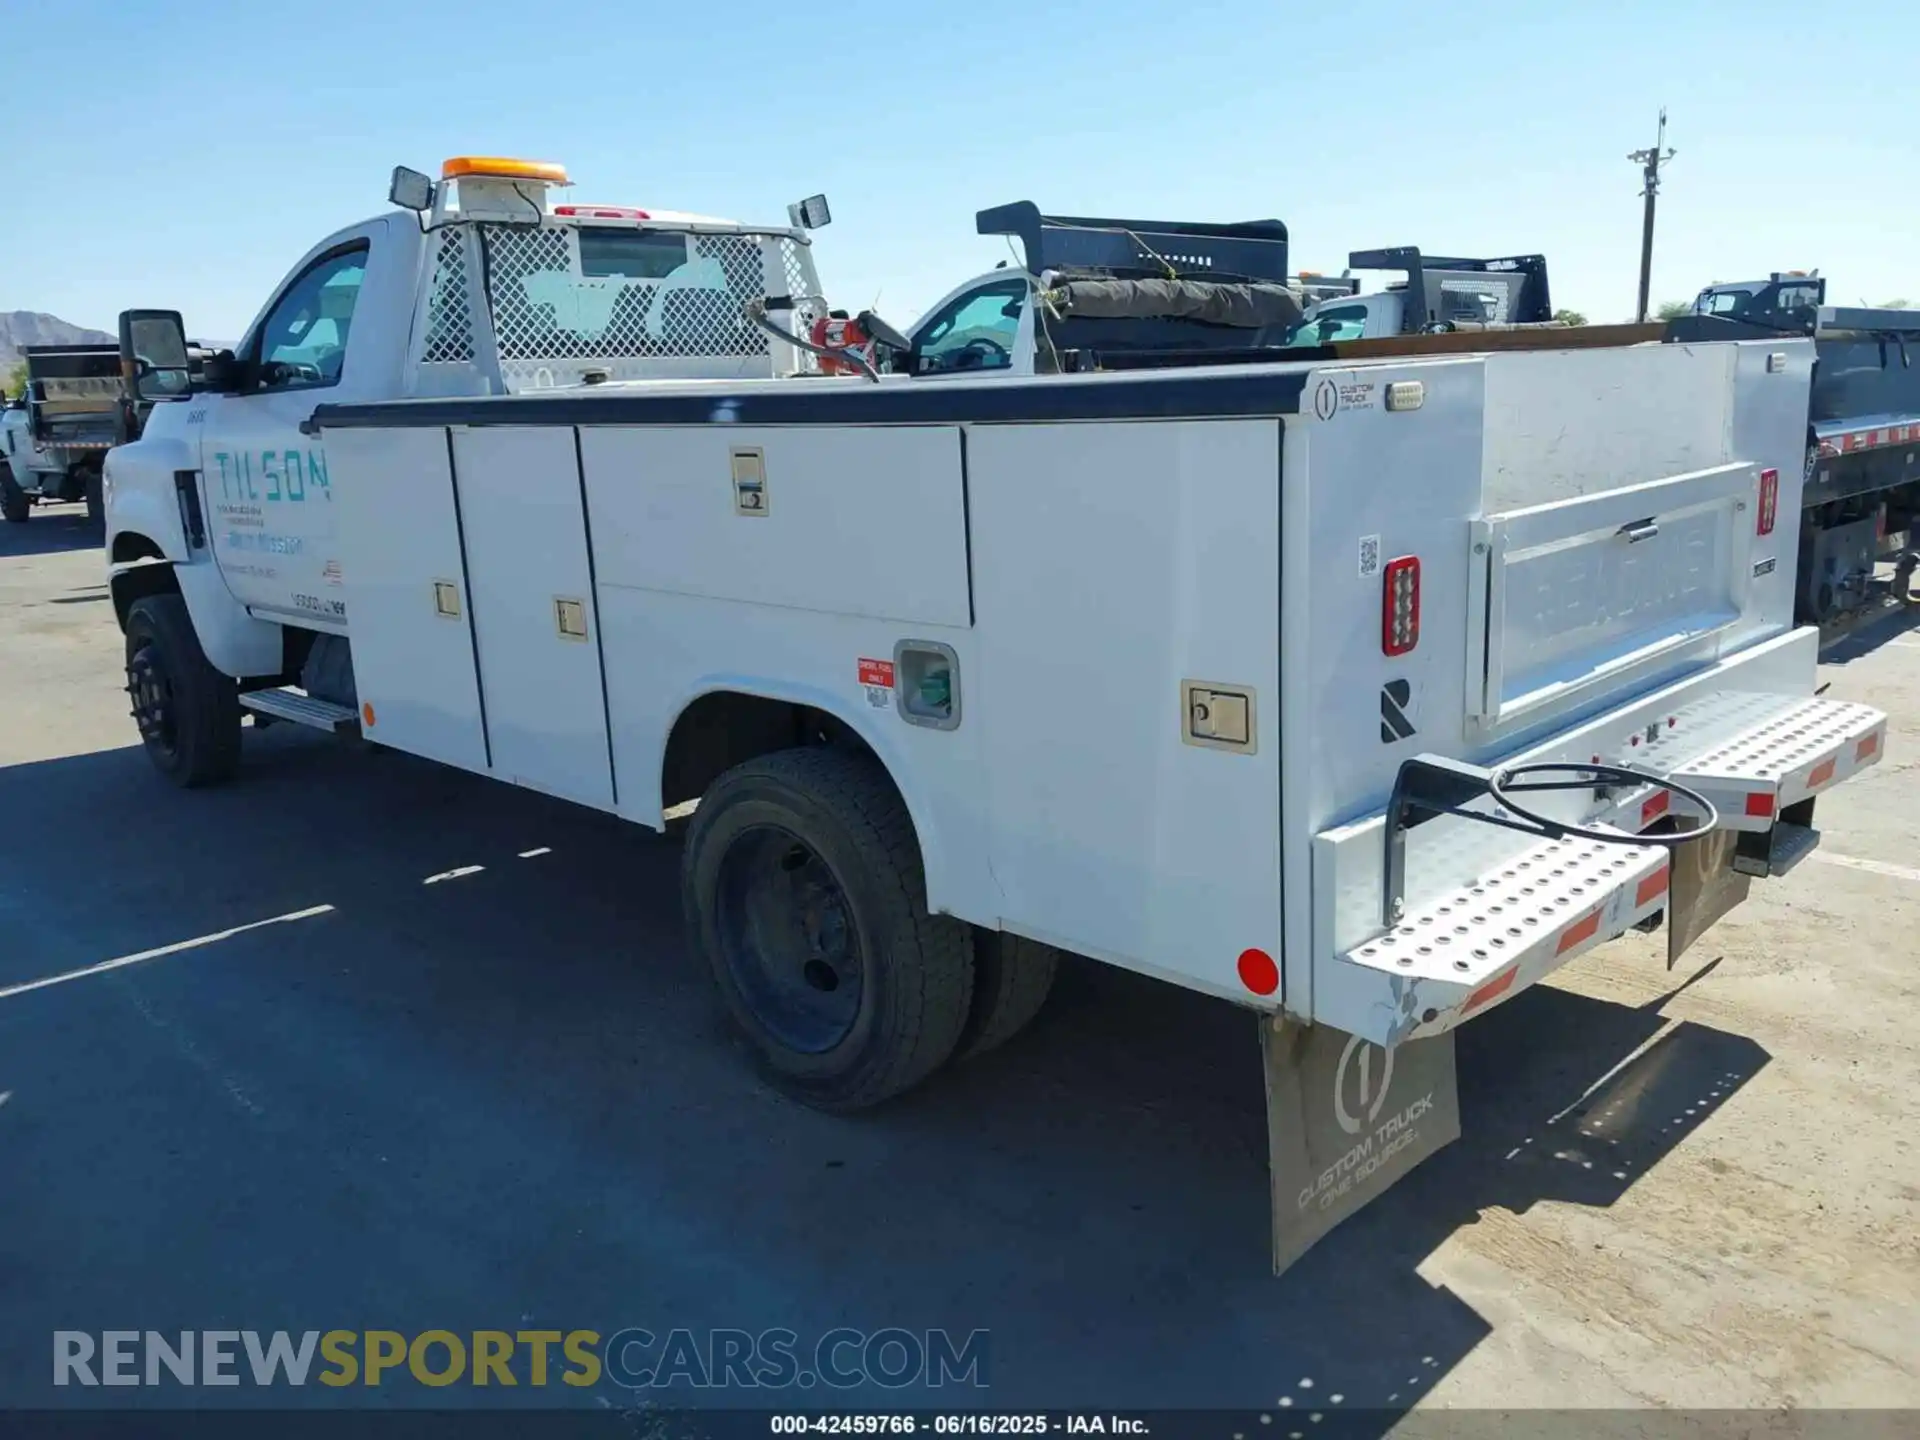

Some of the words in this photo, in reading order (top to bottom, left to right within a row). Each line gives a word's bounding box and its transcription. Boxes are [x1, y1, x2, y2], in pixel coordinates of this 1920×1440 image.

[1340, 384, 1374, 394] CUSTOM
[1340, 394, 1366, 404] TRUCK
[215, 448, 332, 501] TILSON
[1298, 1136, 1373, 1210] CUSTOM
[1375, 1092, 1433, 1145] TRUCK
[1320, 1180, 1352, 1210] ONE
